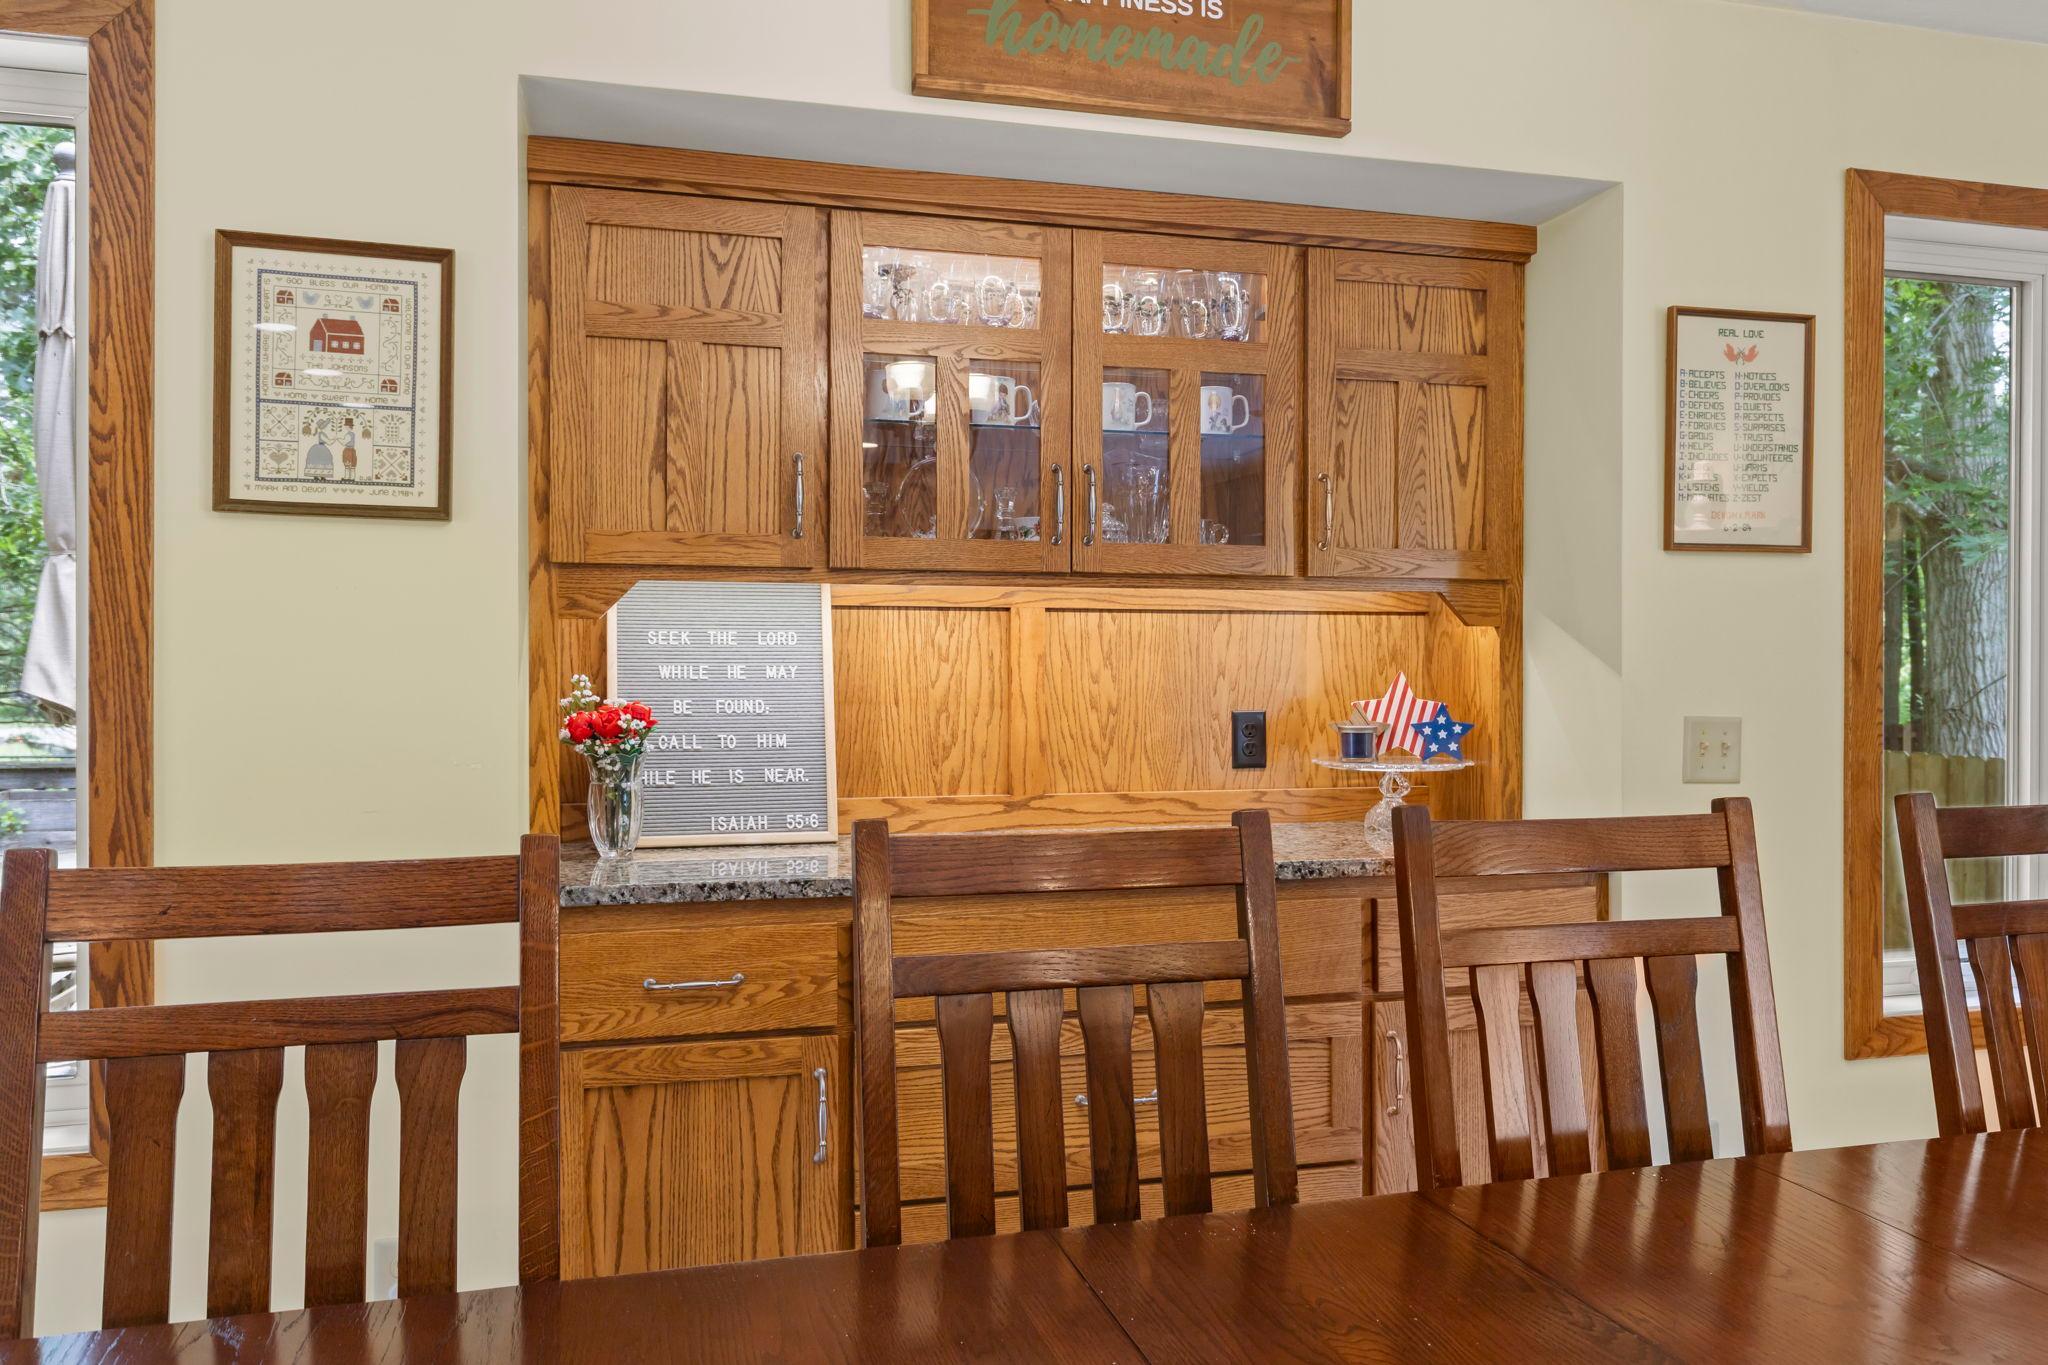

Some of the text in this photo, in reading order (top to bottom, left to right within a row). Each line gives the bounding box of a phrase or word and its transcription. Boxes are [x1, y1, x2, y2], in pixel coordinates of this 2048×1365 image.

[1201, 0, 1223, 19] IS
[967, 0, 1301, 87] homemade
[1718, 328, 1765, 339] REAL LOVE
[647, 631, 798, 646] SEEK THE LORD
[658, 665, 798, 680] WHILE HE MAY
[673, 699, 692, 714] BE
[659, 733, 787, 749] CALL TO HIM
[641, 768, 809, 785] HILE HE IS NEAR.
[711, 813, 819, 831] ISAIAH 55:6
